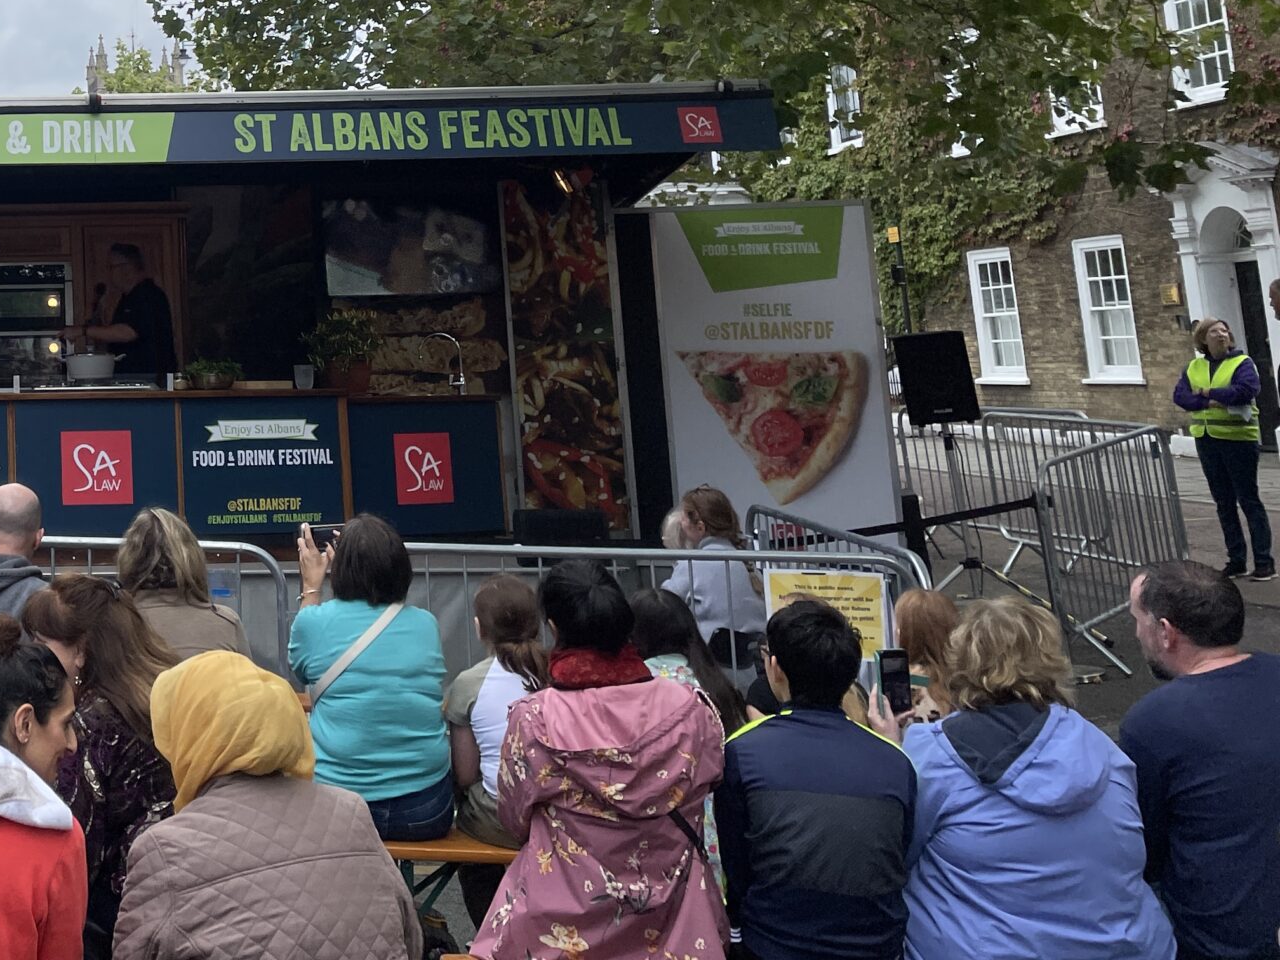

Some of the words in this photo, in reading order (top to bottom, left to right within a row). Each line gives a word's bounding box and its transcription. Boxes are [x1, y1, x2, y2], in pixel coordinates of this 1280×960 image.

[6, 120, 31, 156] &
[42, 119, 136, 154] DRINK
[233, 113, 277, 154] ST
[290, 110, 428, 152] ALBANS
[439, 107, 633, 150] FEASTIVAL
[727, 224, 750, 234] Enjoy
[751, 224, 761, 232] St
[763, 223, 793, 232] Albans
[701, 244, 728, 257] FOOD
[738, 243, 771, 256] DRINK
[773, 242, 821, 255] FESTIVAL
[742, 303, 793, 317] #SELFIE
[704, 320, 835, 341] @STALBANSFDF
[224, 425, 252, 437] Enjoy
[254, 424, 265, 434] St
[267, 423, 301, 434] Albans
[192, 450, 225, 467] FOOD
[227, 451, 235, 467] &
[237, 449, 275, 466] DRINK
[278, 448, 334, 465] FESTIVAL
[73, 443, 120, 492] SA
[404, 445, 442, 492] SA
[94, 479, 122, 492] LAW
[423, 479, 444, 492] LAW
[227, 497, 302, 512] @STALBANSFDF
[207, 514, 268, 525] #ENJOYSTALBANS
[272, 512, 322, 523] #STALBANSFDF
